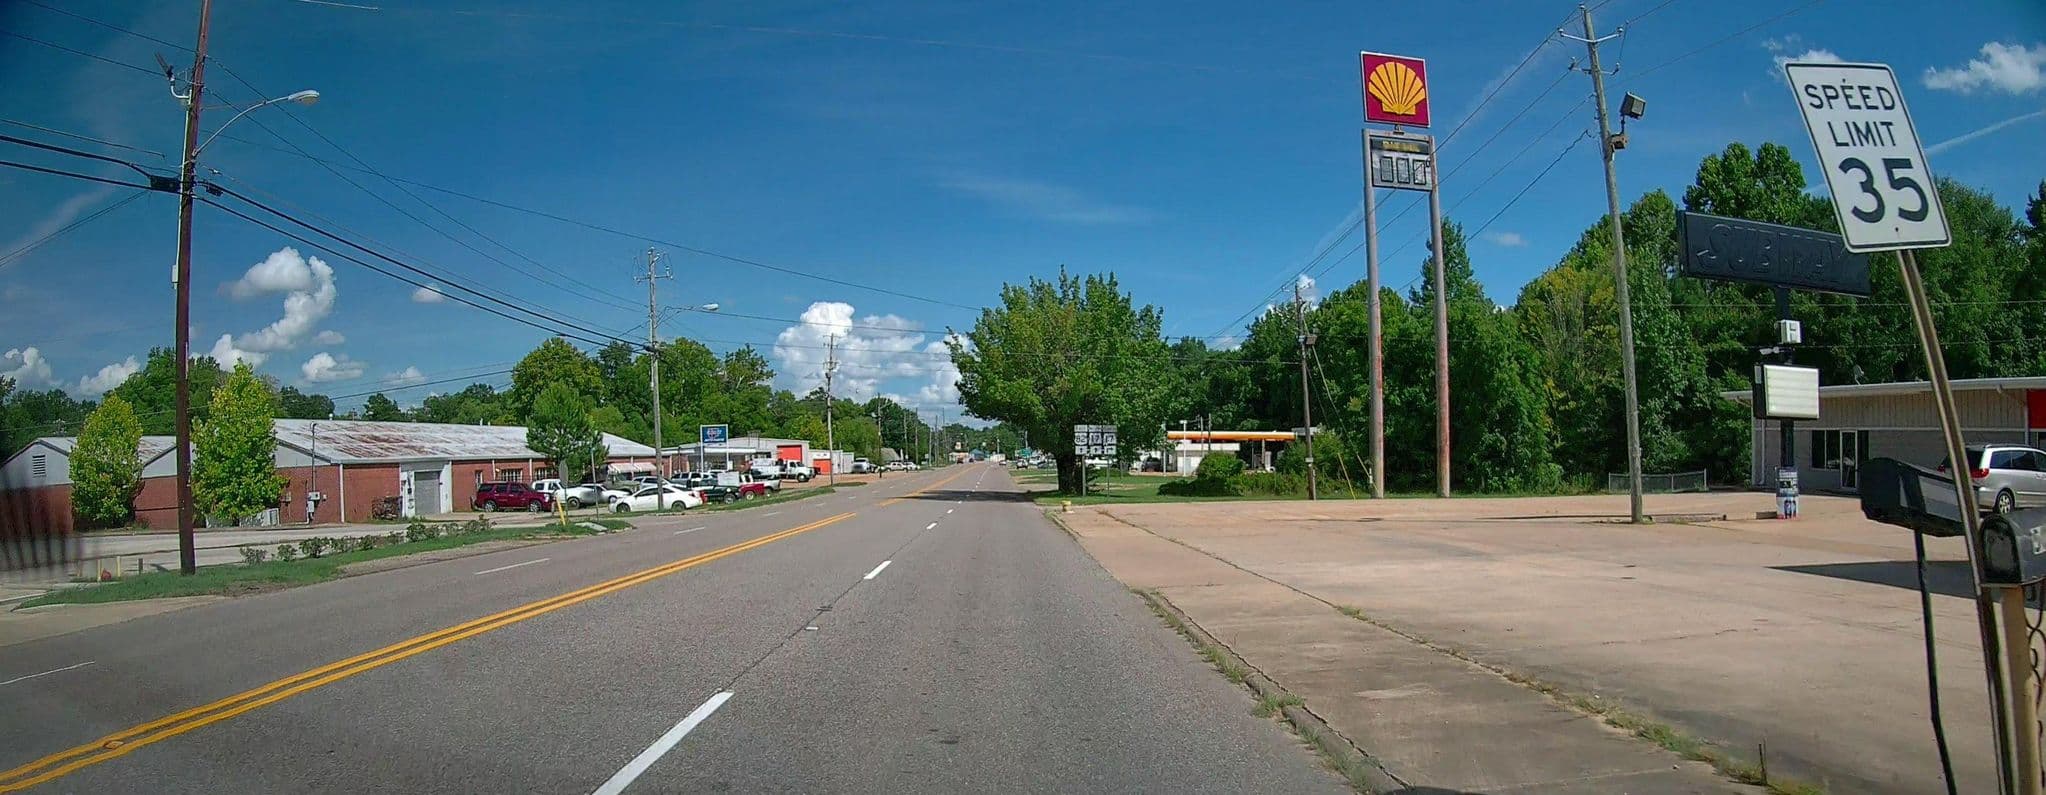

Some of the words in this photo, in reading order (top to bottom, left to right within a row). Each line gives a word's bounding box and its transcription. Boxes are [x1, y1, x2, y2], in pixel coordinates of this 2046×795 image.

[1804, 84, 1896, 111] SPEED
[1827, 121, 1897, 147] LIMIT
[1838, 157, 1929, 223] 35
[1091, 434, 1100, 442] 17
[1105, 435, 1114, 443] 17
